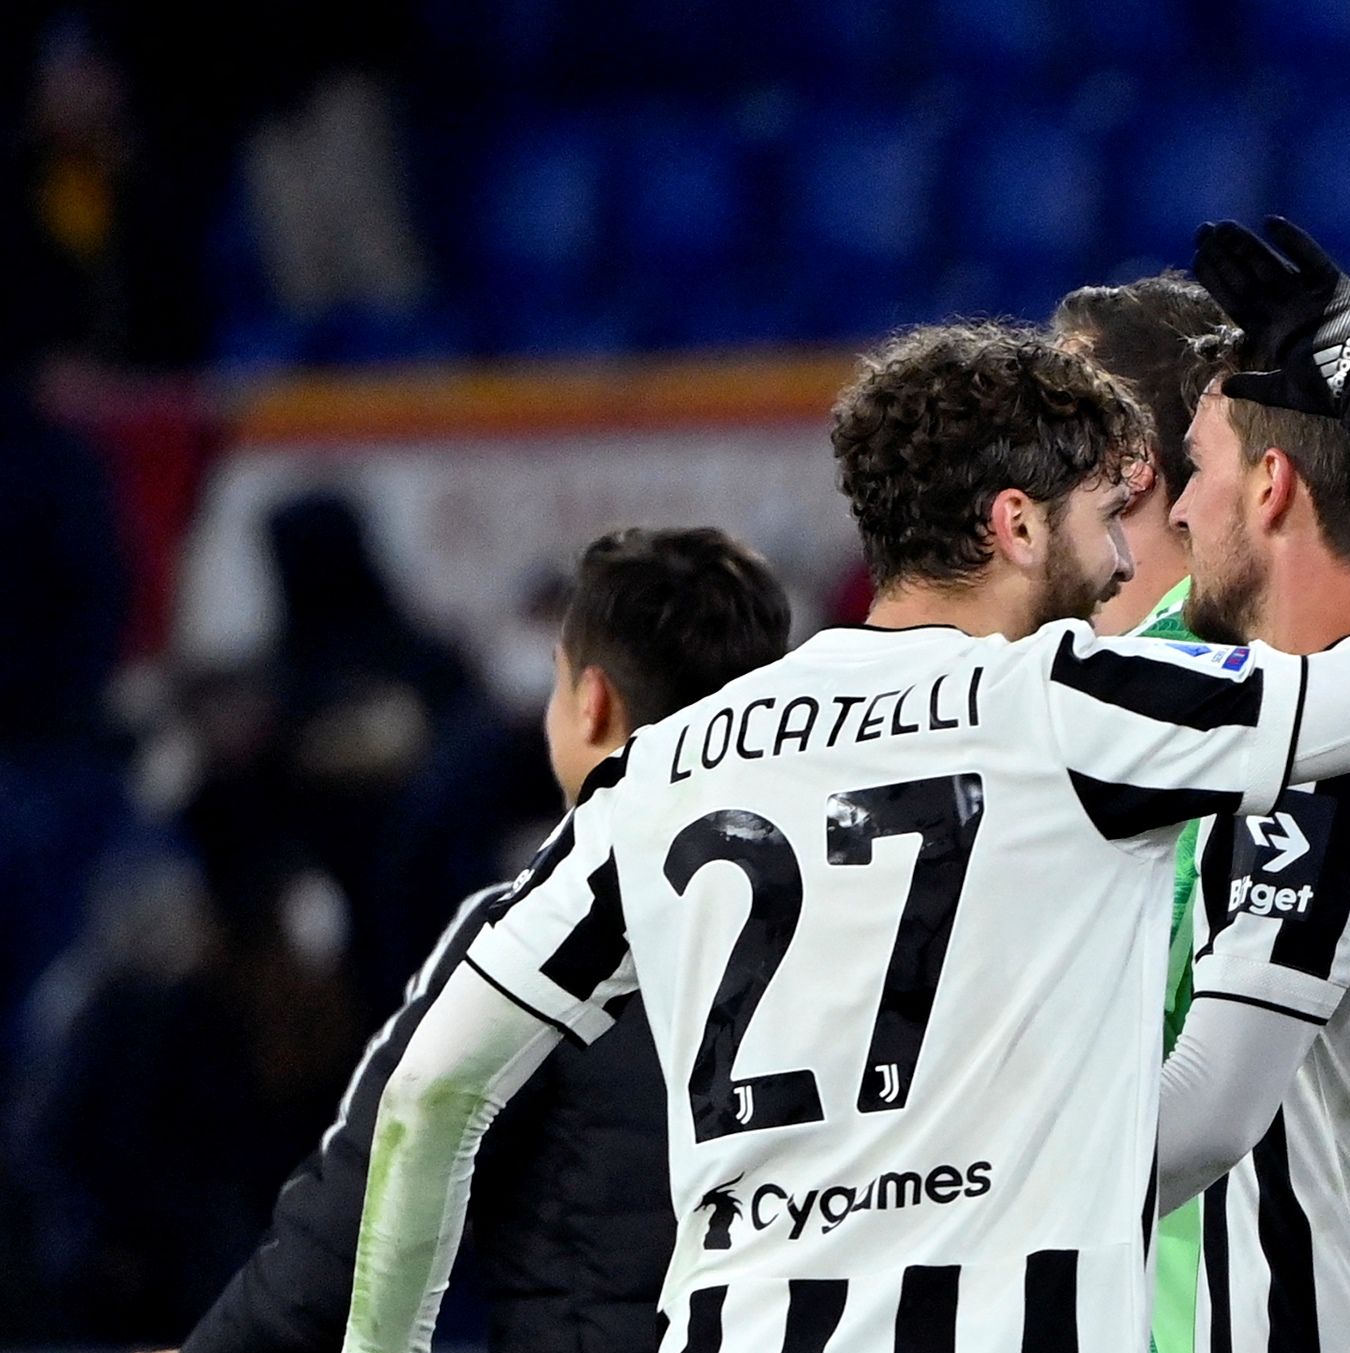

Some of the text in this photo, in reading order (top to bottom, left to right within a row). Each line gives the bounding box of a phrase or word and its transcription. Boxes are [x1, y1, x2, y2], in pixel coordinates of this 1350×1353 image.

[670, 666, 984, 784] LOCATELLI
[663, 773, 985, 1144] 27
[752, 1161, 992, 1240] Cygames
